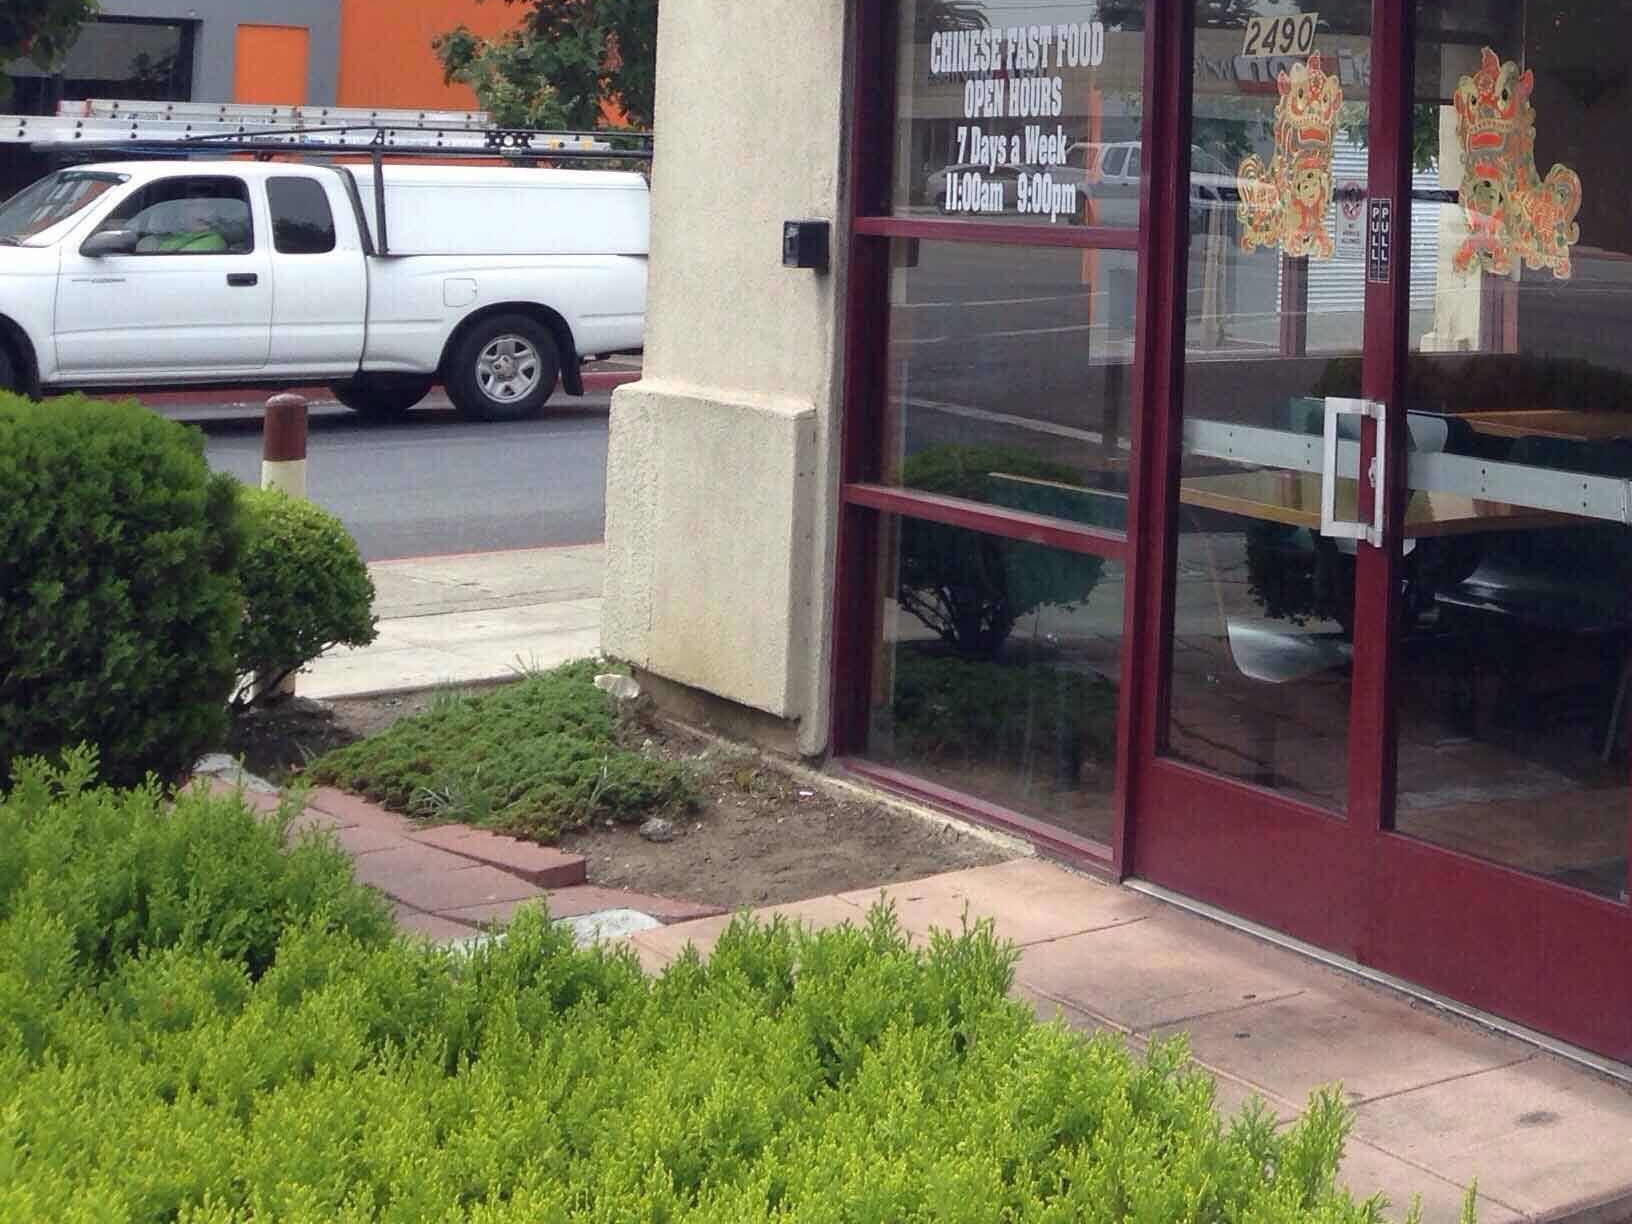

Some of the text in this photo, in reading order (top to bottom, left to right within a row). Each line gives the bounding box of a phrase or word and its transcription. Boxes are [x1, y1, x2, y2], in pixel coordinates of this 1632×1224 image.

[931, 22, 1105, 73] CHINESE FAST FOOD
[1244, 16, 1313, 55] 2490
[964, 76, 1063, 118] OPEN HOURS
[957, 124, 1068, 174] 7 Days a Week
[945, 171, 1077, 224] 11:00am 9:00pm
[1371, 207, 1380, 261] PULL
[1381, 207, 1390, 262] PULL
